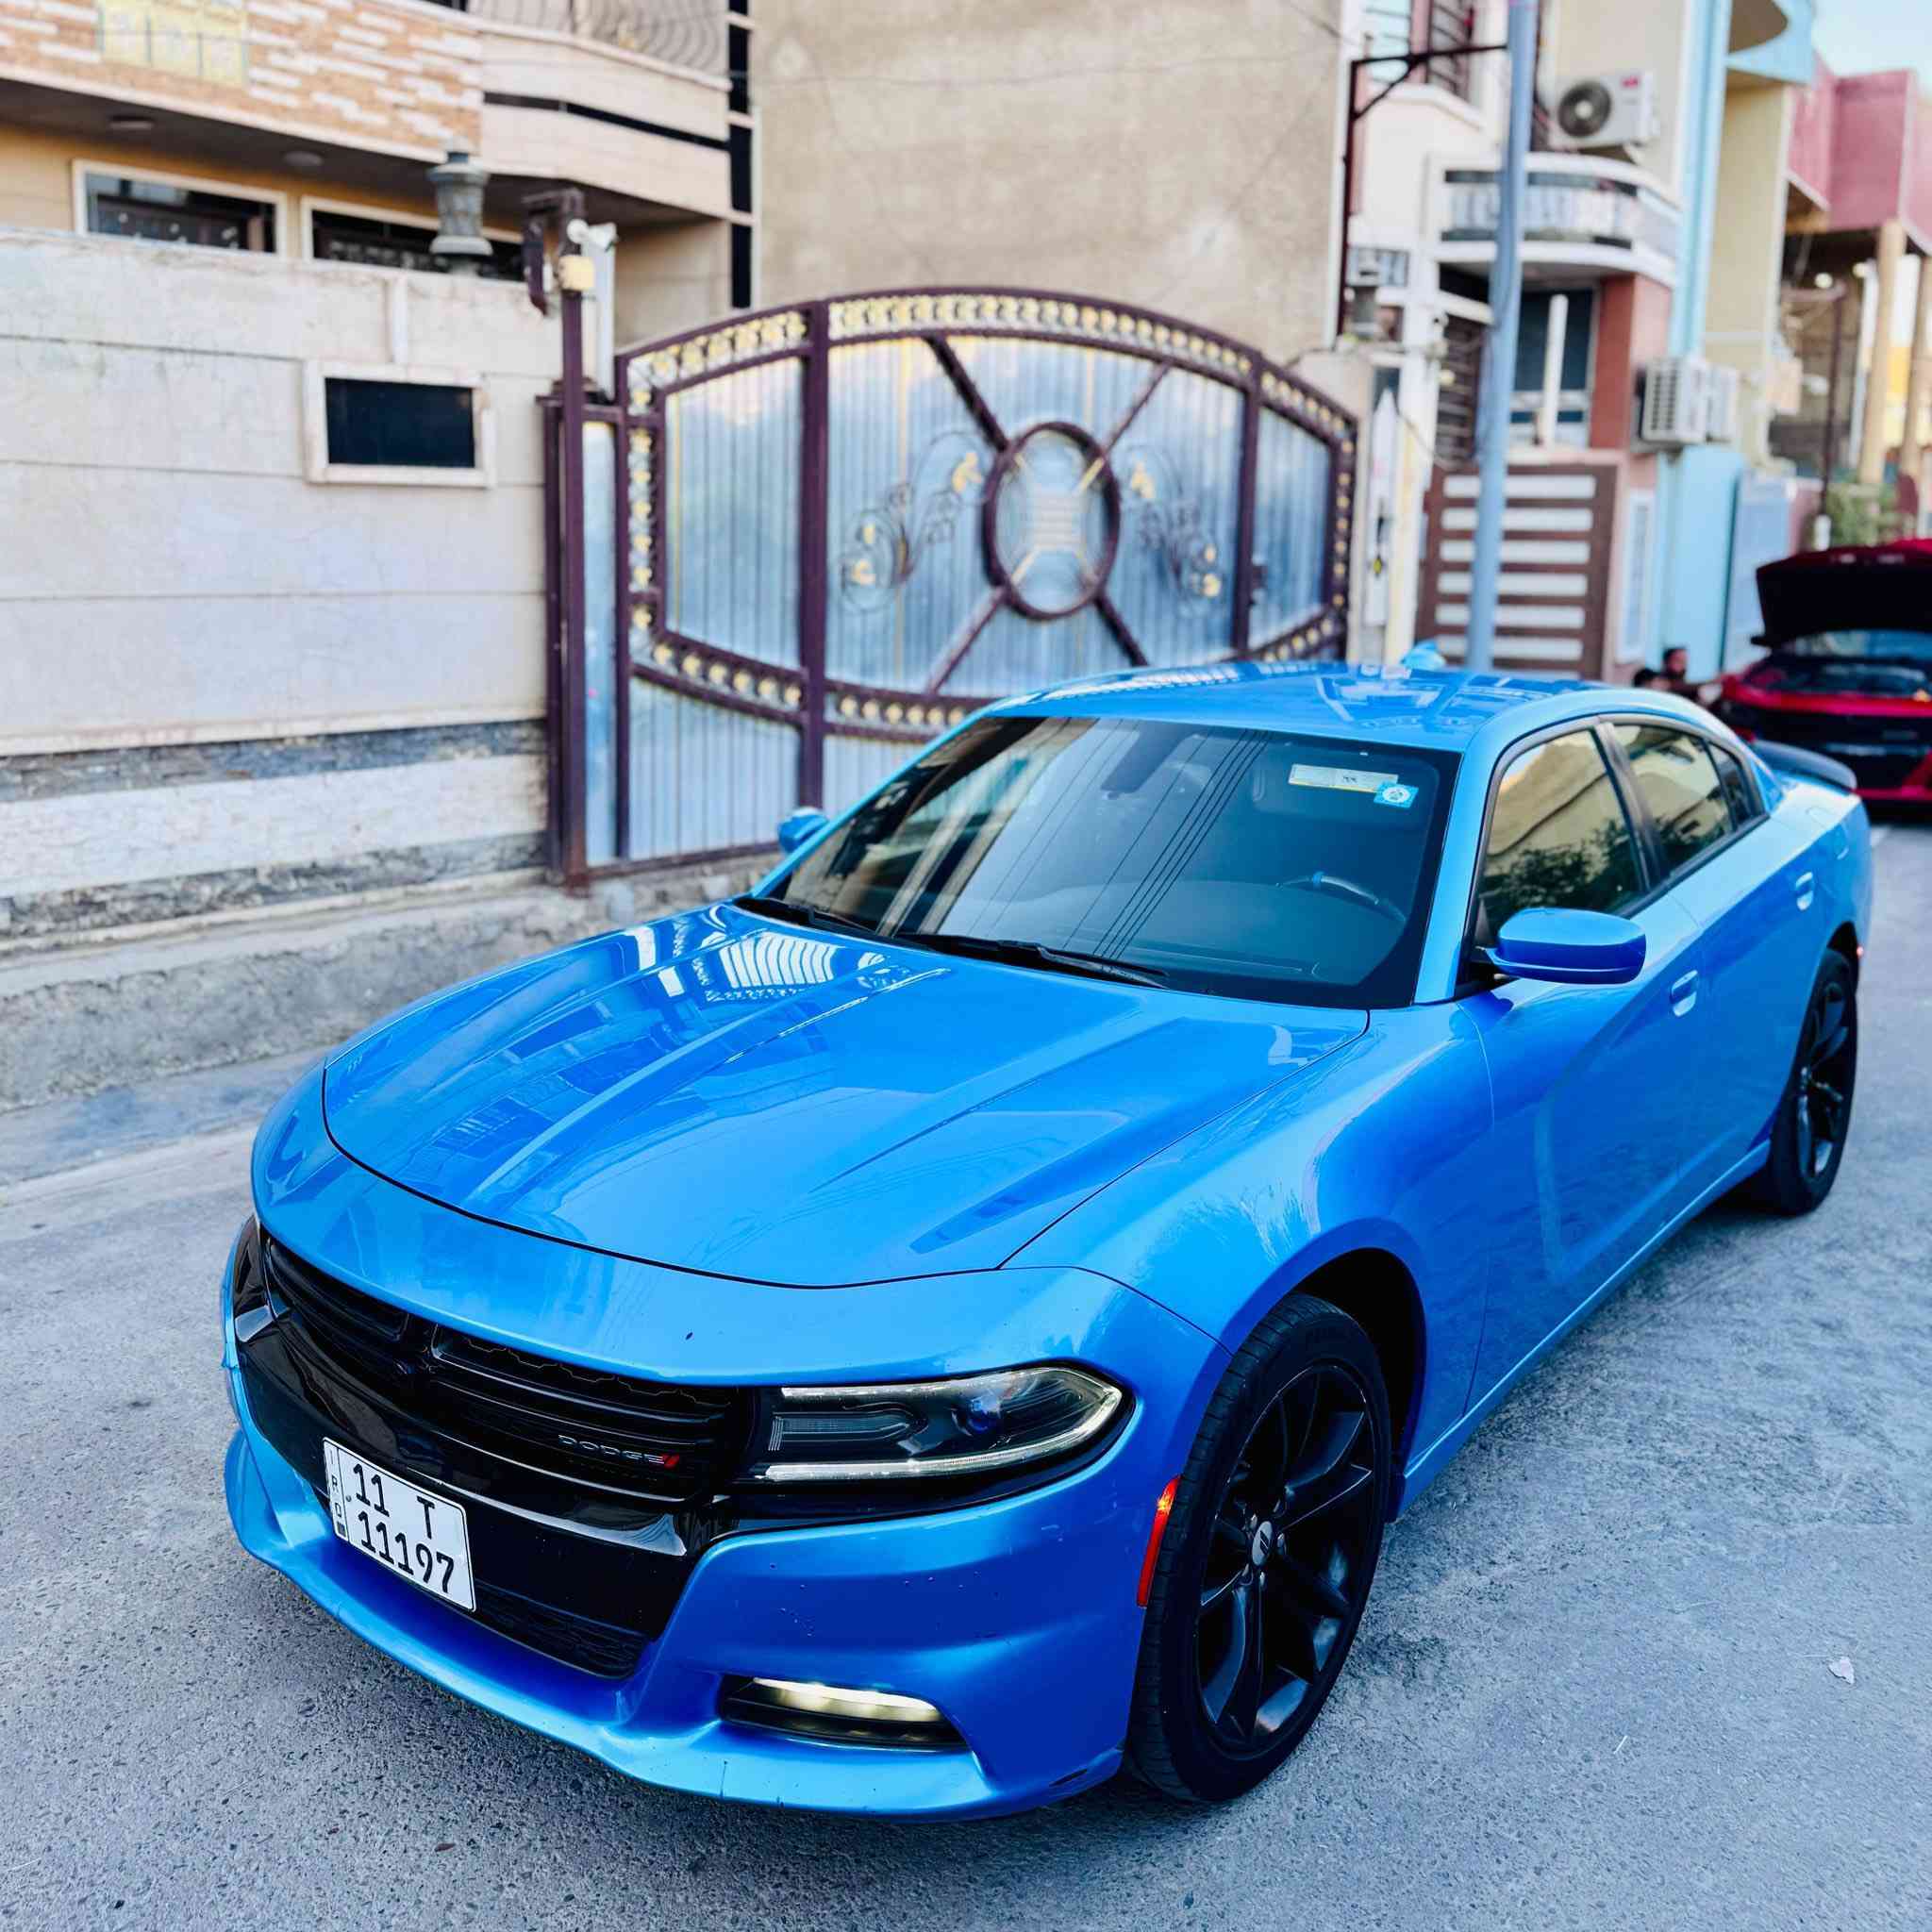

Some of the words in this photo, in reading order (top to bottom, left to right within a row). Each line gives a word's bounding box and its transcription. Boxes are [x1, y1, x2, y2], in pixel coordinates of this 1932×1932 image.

[558, 1435, 665, 1464] DODGE
[354, 1464, 389, 1517] 11
[417, 1495, 435, 1539] T
[358, 1511, 454, 1592] 11197
